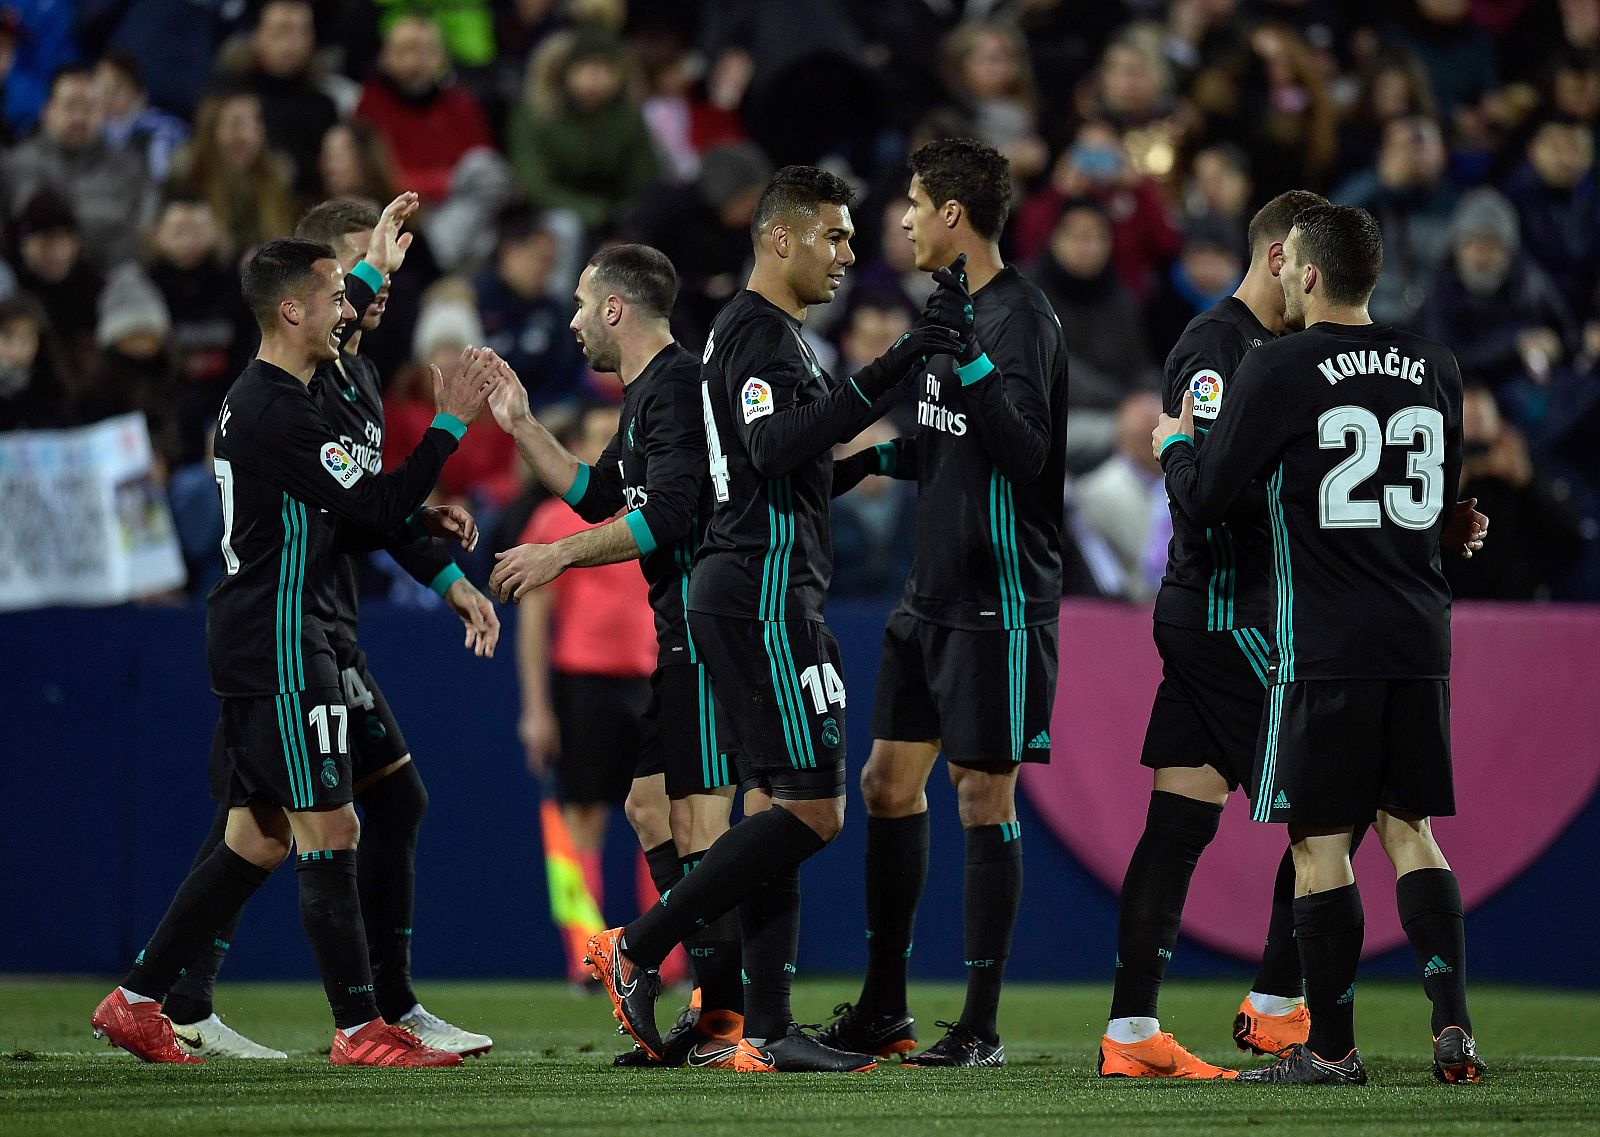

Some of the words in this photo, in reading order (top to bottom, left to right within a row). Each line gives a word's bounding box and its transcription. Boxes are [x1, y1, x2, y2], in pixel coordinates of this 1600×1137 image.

[1317, 347, 1426, 386] KOVAČIĆ
[926, 372, 941, 402] Fly
[746, 405, 771, 418] LaLiga
[917, 399, 968, 437] mirates
[1193, 403, 1218, 414] aLiga
[340, 464, 359, 483] LaLiga
[1317, 404, 1445, 531] 23
[800, 662, 847, 715] 14
[308, 704, 348, 754] 17
[1424, 965, 1454, 979] adidas
